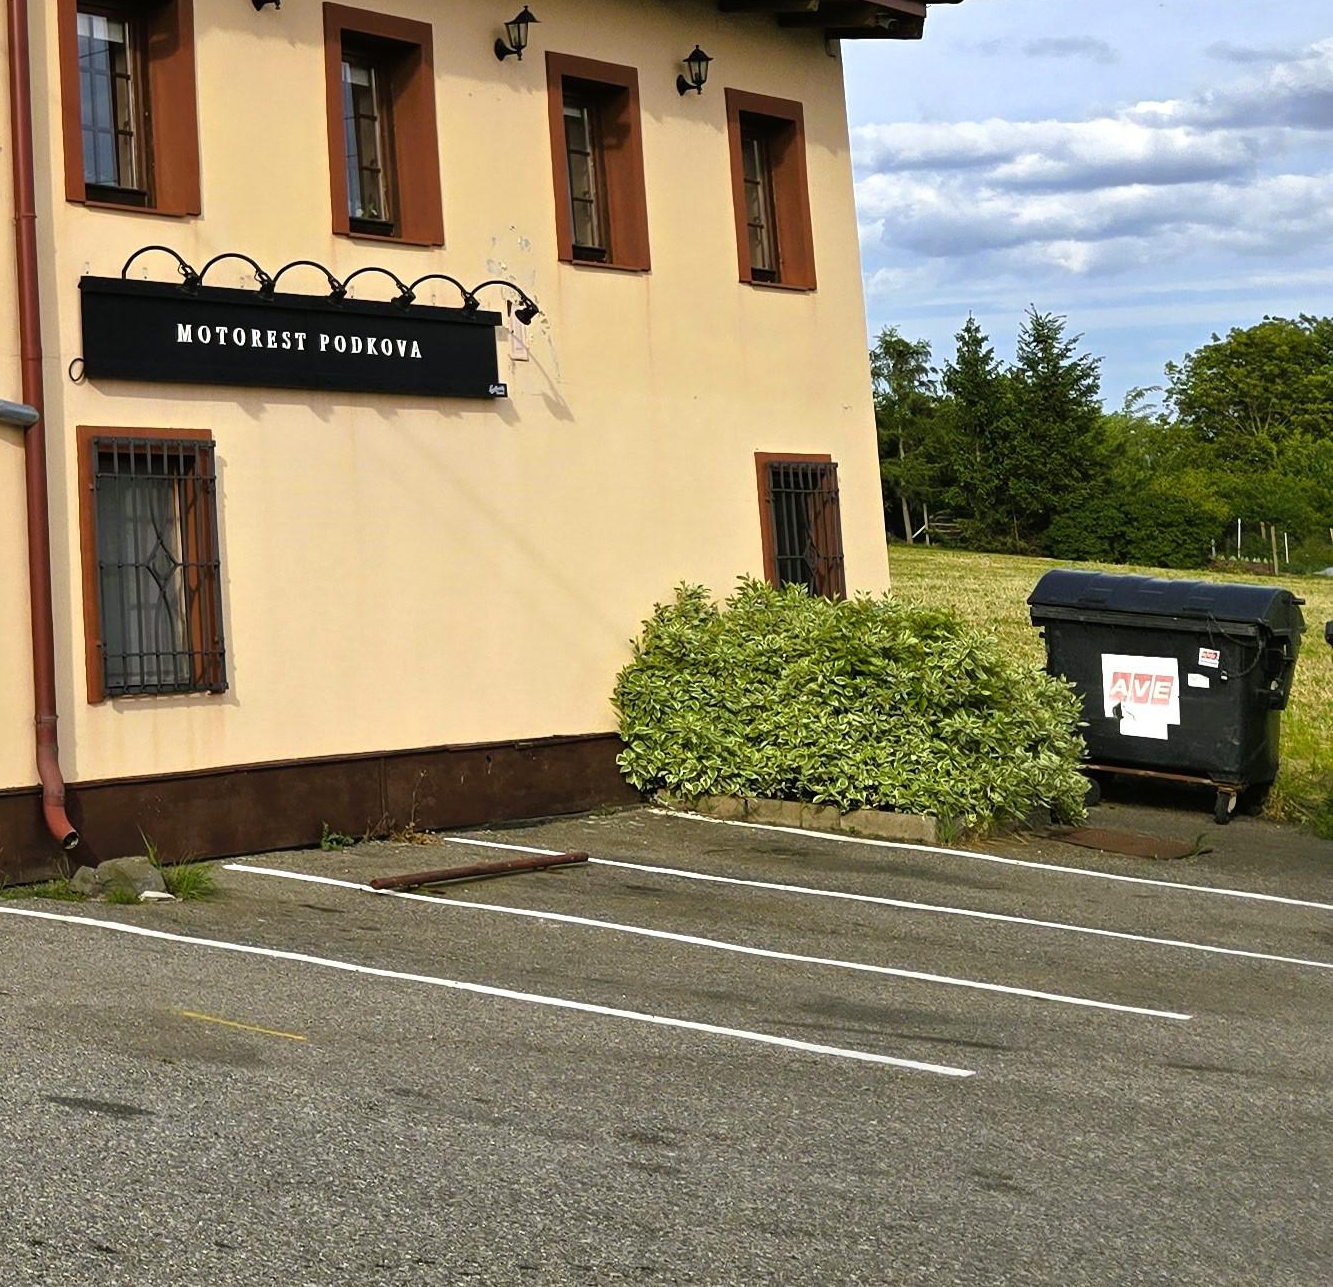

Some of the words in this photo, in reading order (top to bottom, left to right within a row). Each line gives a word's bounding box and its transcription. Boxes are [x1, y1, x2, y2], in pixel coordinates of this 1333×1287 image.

[176, 323, 307, 351] MOTOREST
[319, 333, 423, 359] PODKOVA
[1109, 674, 1172, 702] AVE
